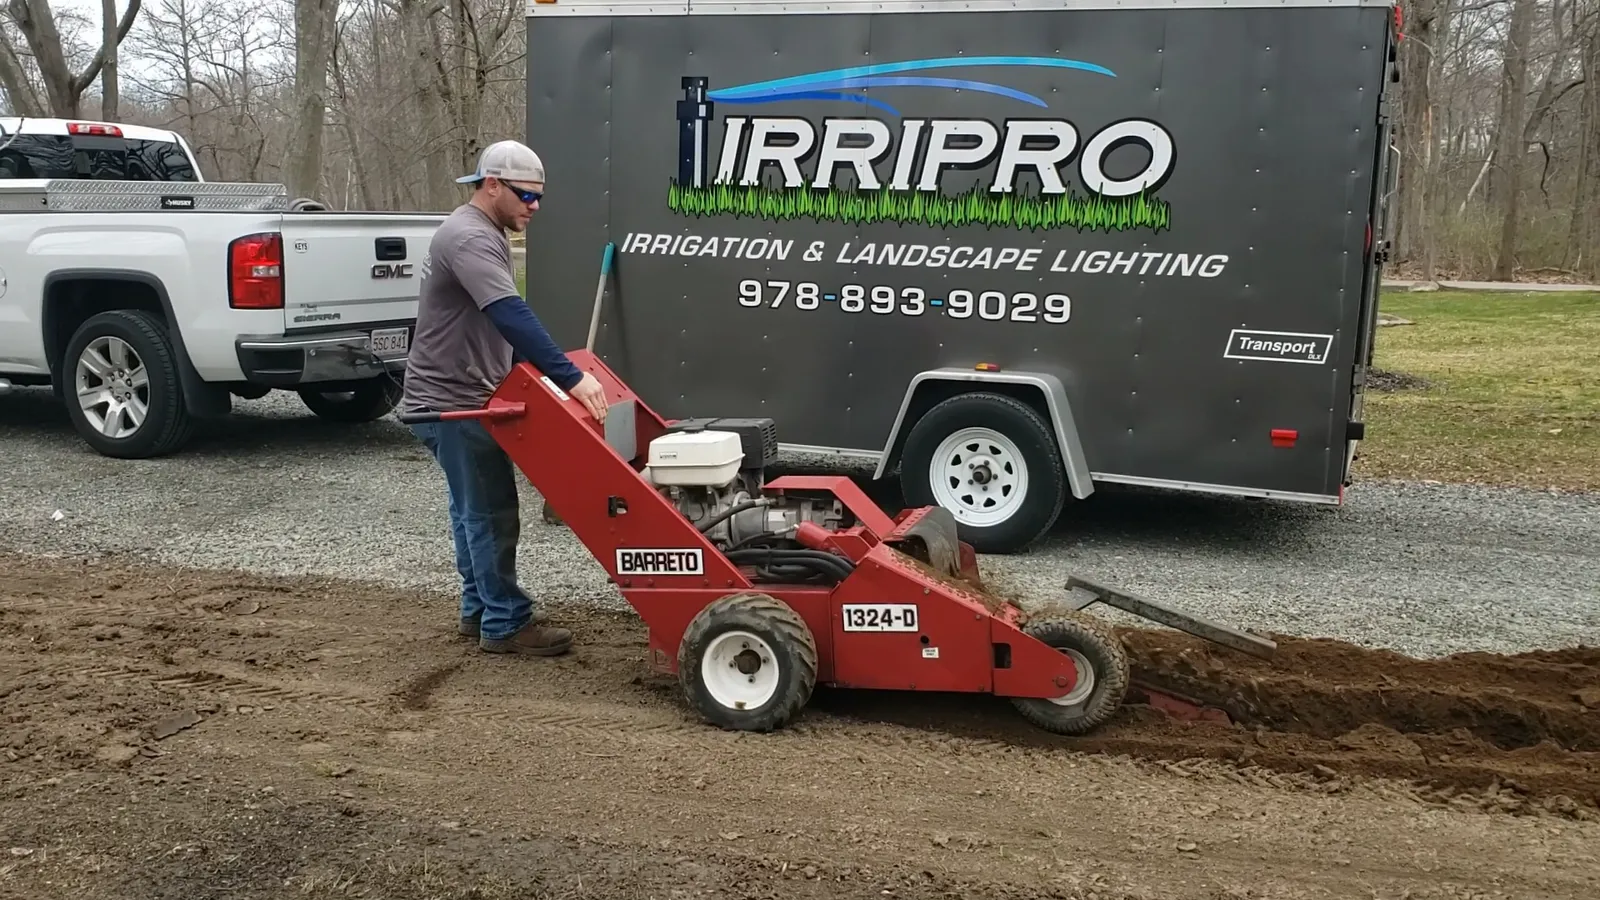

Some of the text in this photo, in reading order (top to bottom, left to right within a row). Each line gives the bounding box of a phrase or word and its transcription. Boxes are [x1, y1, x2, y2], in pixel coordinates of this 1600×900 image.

[713, 116, 1175, 198] IRRIPRO
[294, 242, 308, 251] KEYS
[620, 232, 1230, 278] IRRIGATION & LANDSCAPE LIGHTING
[371, 264, 414, 279] GMC
[737, 278, 1073, 325] 978-893-9029
[293, 312, 342, 323] SIERRA
[373, 334, 407, 352] 5SC 841
[1239, 337, 1316, 355] Transport
[621, 552, 698, 572] BARRETO
[846, 606, 915, 628] 1324-D
